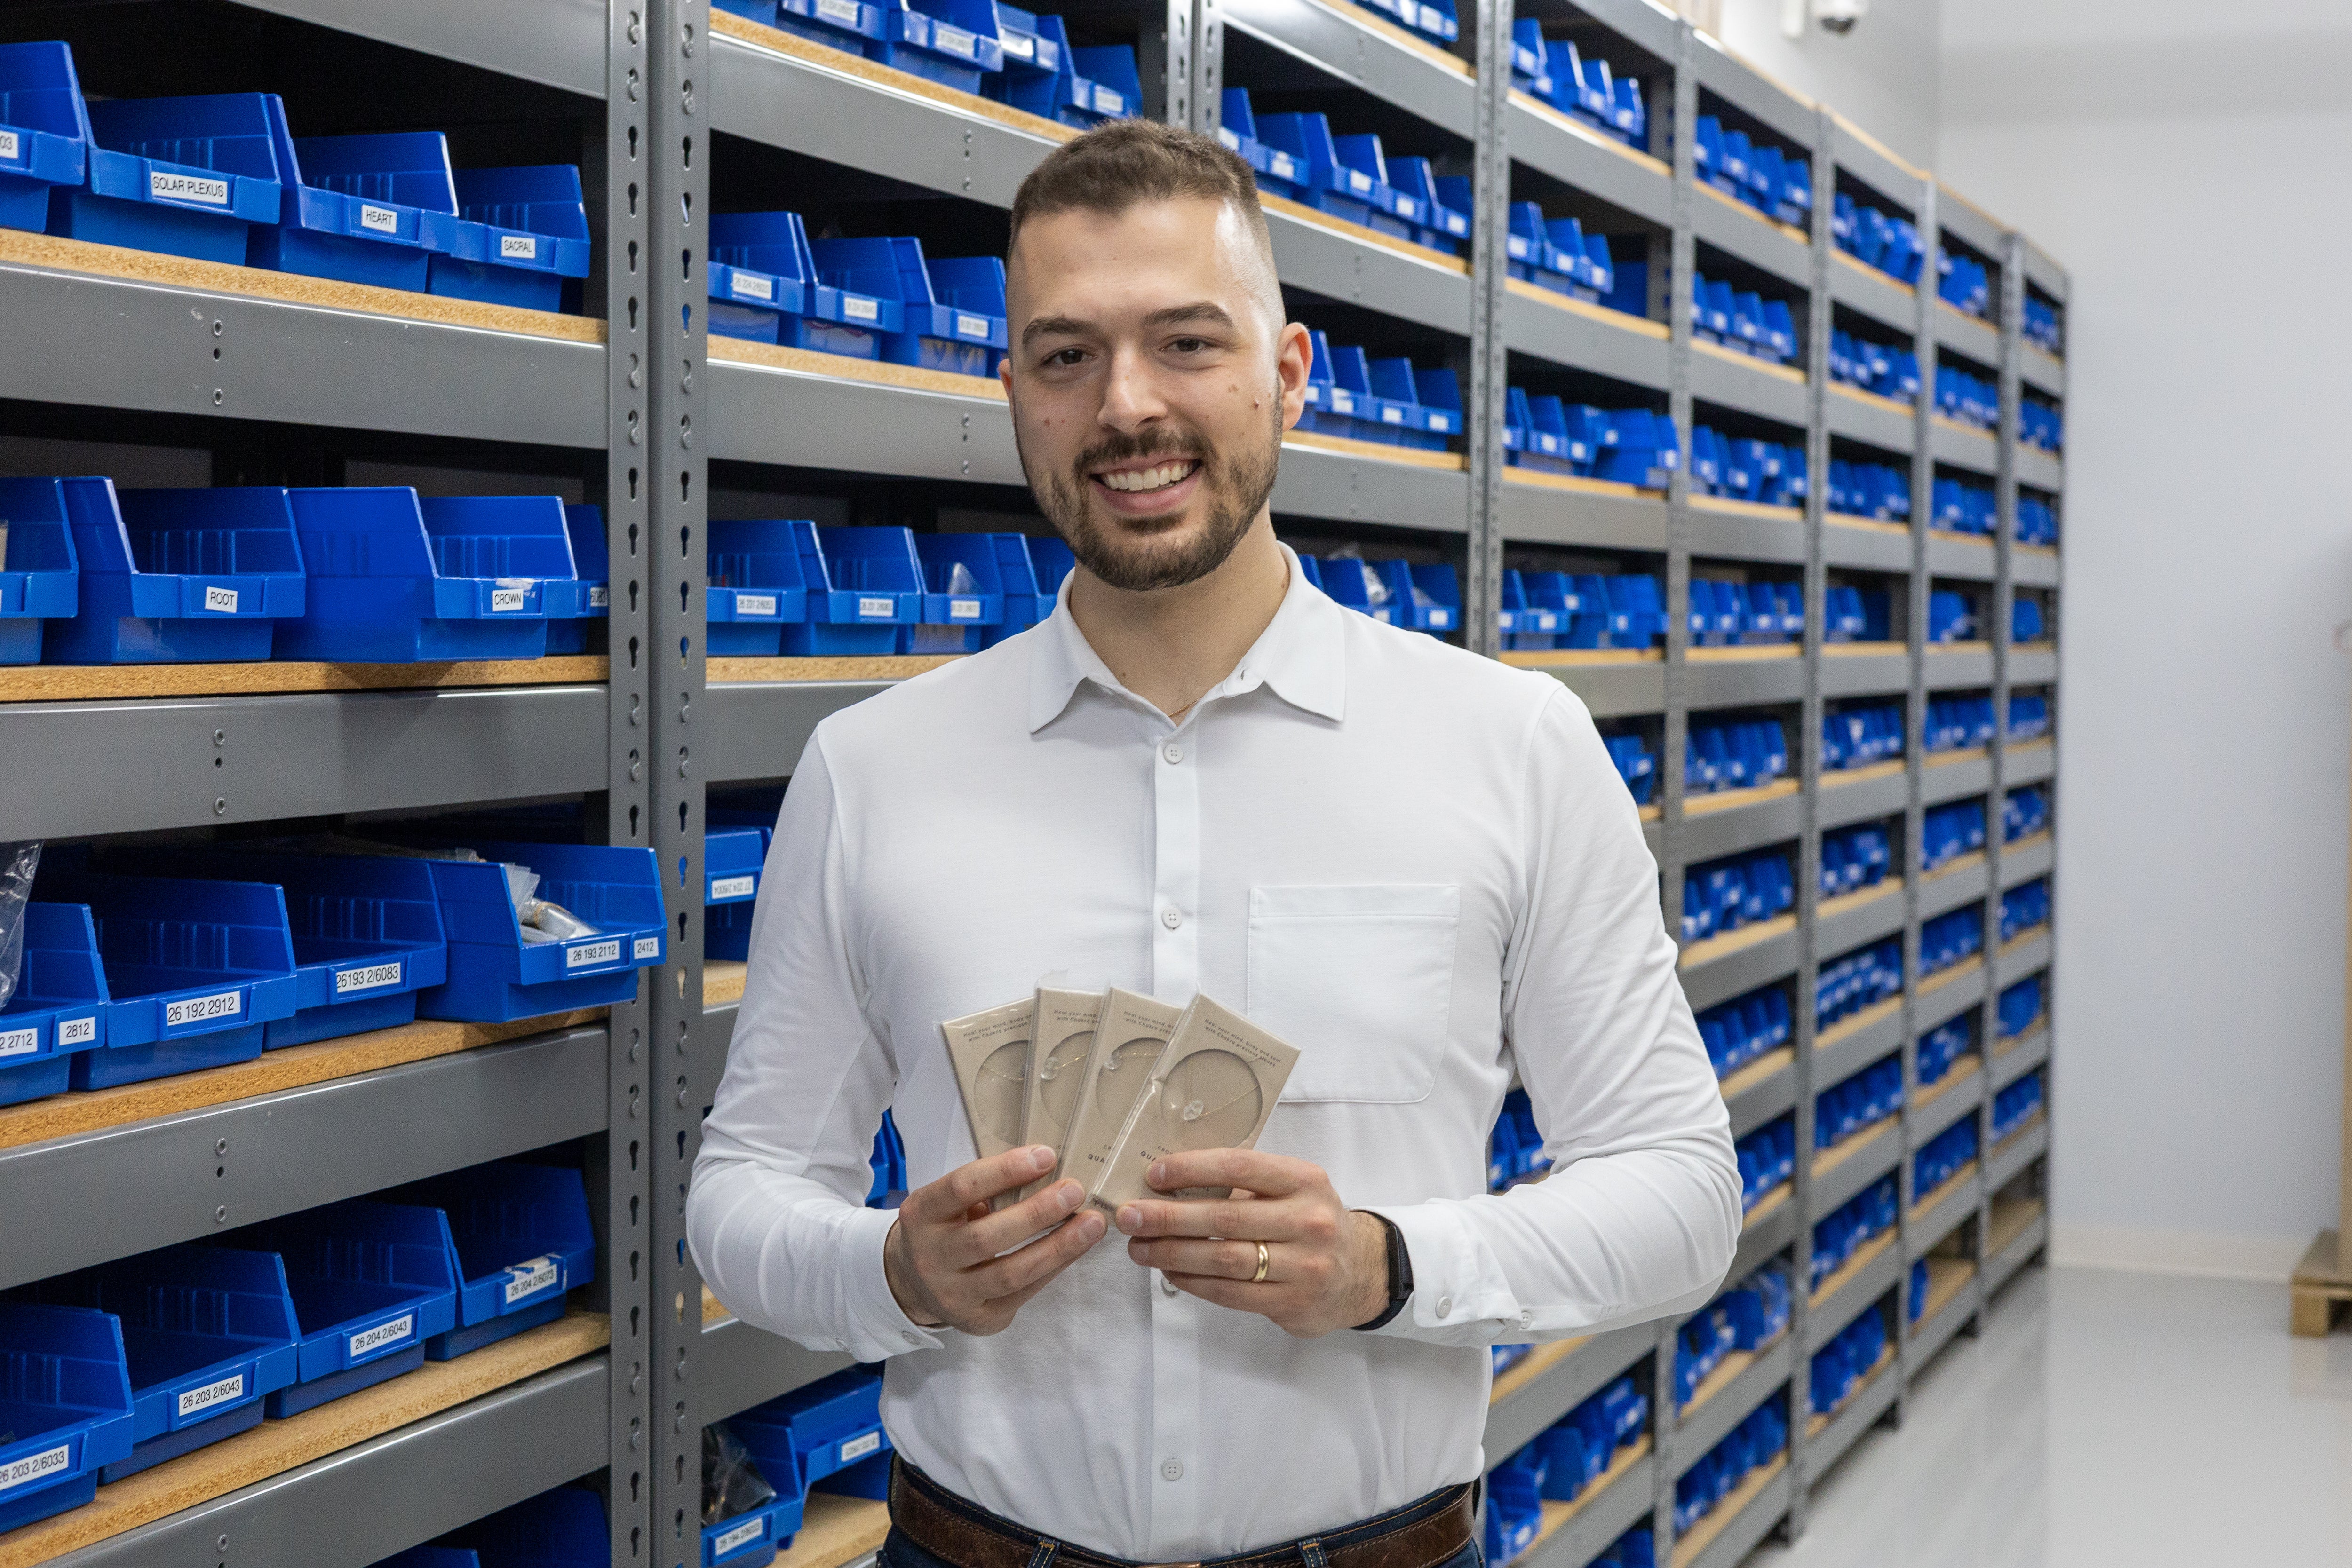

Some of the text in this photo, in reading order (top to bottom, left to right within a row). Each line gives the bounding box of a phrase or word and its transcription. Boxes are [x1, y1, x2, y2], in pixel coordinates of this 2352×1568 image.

[153, 176, 224, 197] SOLAR PLEXUS
[366, 209, 393, 226] HEART
[504, 240, 532, 252] SACRAL
[210, 591, 235, 606] ROOT
[495, 593, 522, 605] CROWN
[573, 944, 616, 961] 26 193 2112
[637, 942, 654, 954] 2412
[367, 965, 398, 983] 2/6083
[168, 996, 234, 1022] 26 192 2912
[66, 1022, 90, 1038] 2812
[8, 1033, 33, 1048] 2712
[1205, 1019, 1217, 1027] Heal
[1246, 1041, 1258, 1051] body
[1271, 1055, 1281, 1064] soul
[1217, 1032, 1235, 1045] Chakra
[1236, 1043, 1258, 1057] precious
[511, 1283, 519, 1296] 26
[520, 1279, 532, 1292] 204
[355, 1320, 407, 1350] 26 204 2/6043
[183, 1379, 240, 1409] 26 203 2/6043
[12, 1462, 29, 1479] 203
[32, 1450, 64, 1473] 2/6033
